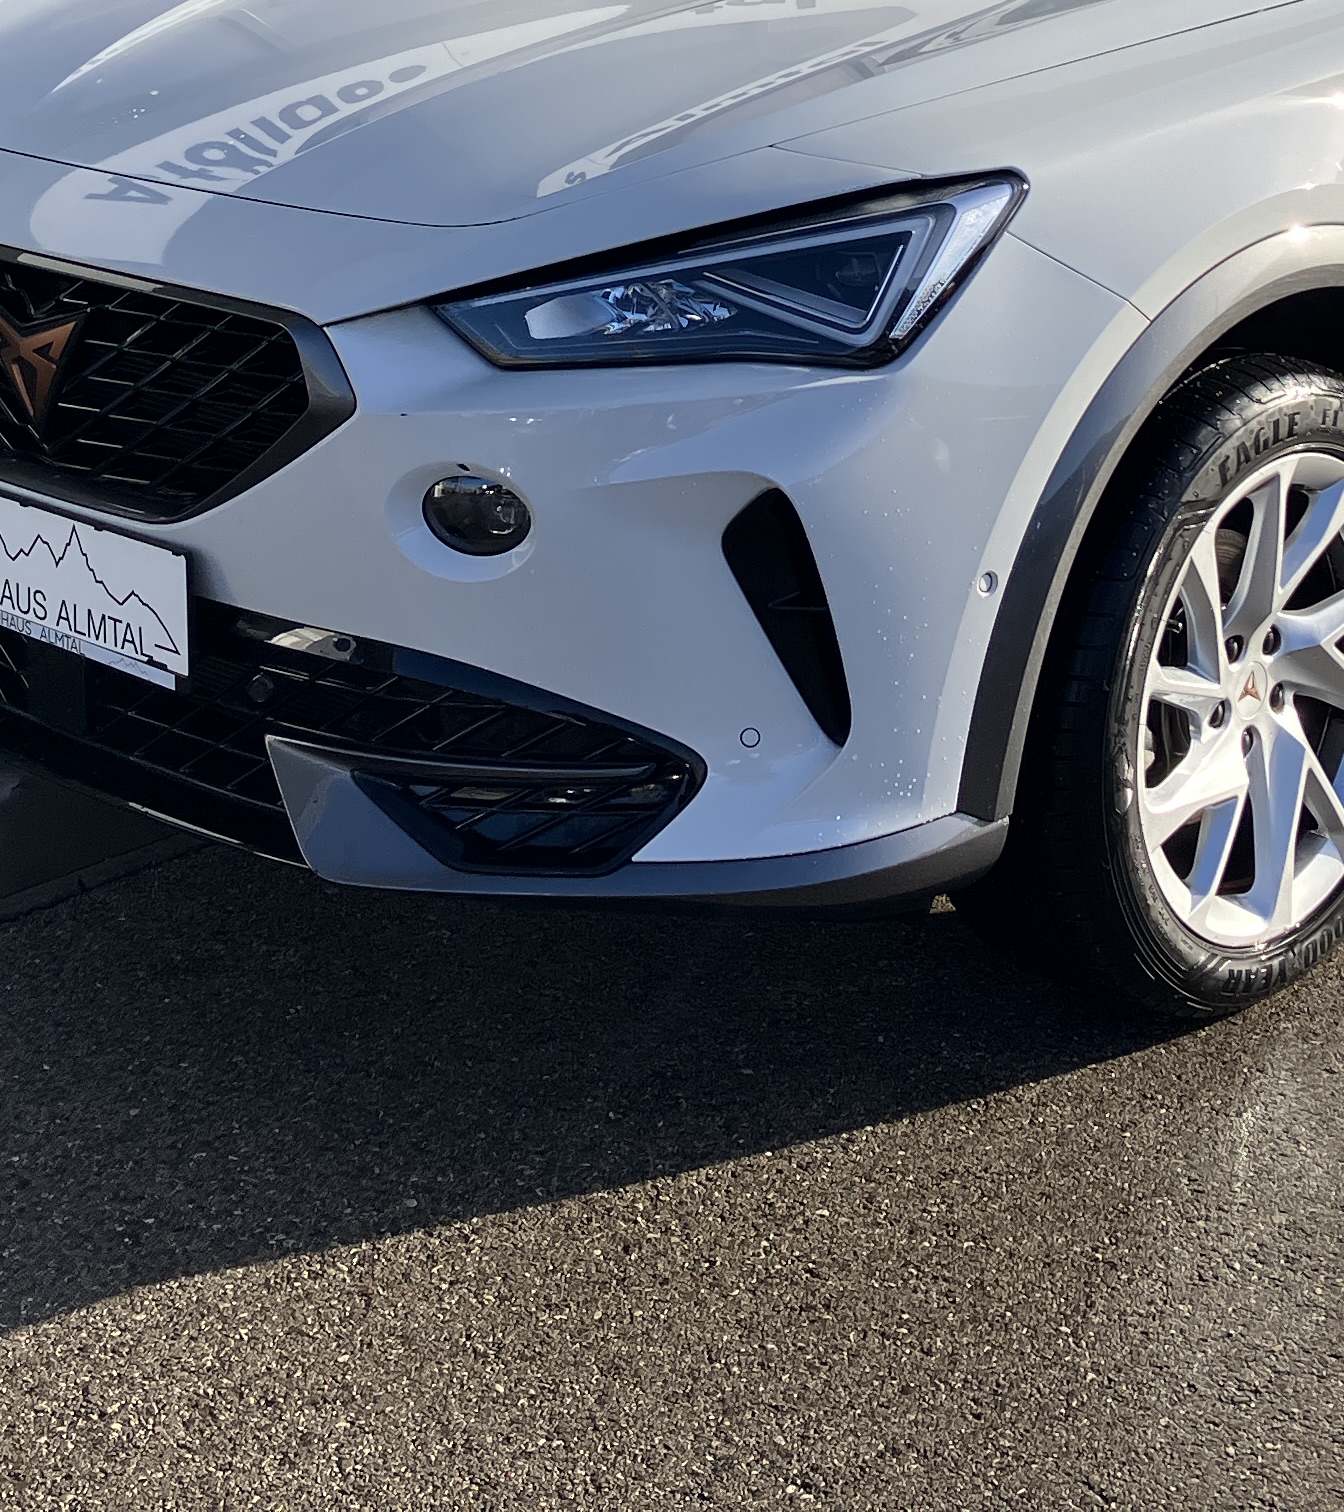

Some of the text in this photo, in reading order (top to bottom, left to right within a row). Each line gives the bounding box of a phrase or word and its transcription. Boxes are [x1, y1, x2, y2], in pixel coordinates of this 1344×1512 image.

[1218, 410, 1301, 488] EAGLE
[39, 626, 86, 658] ALMTAL
[56, 599, 154, 661] ALMTAL
